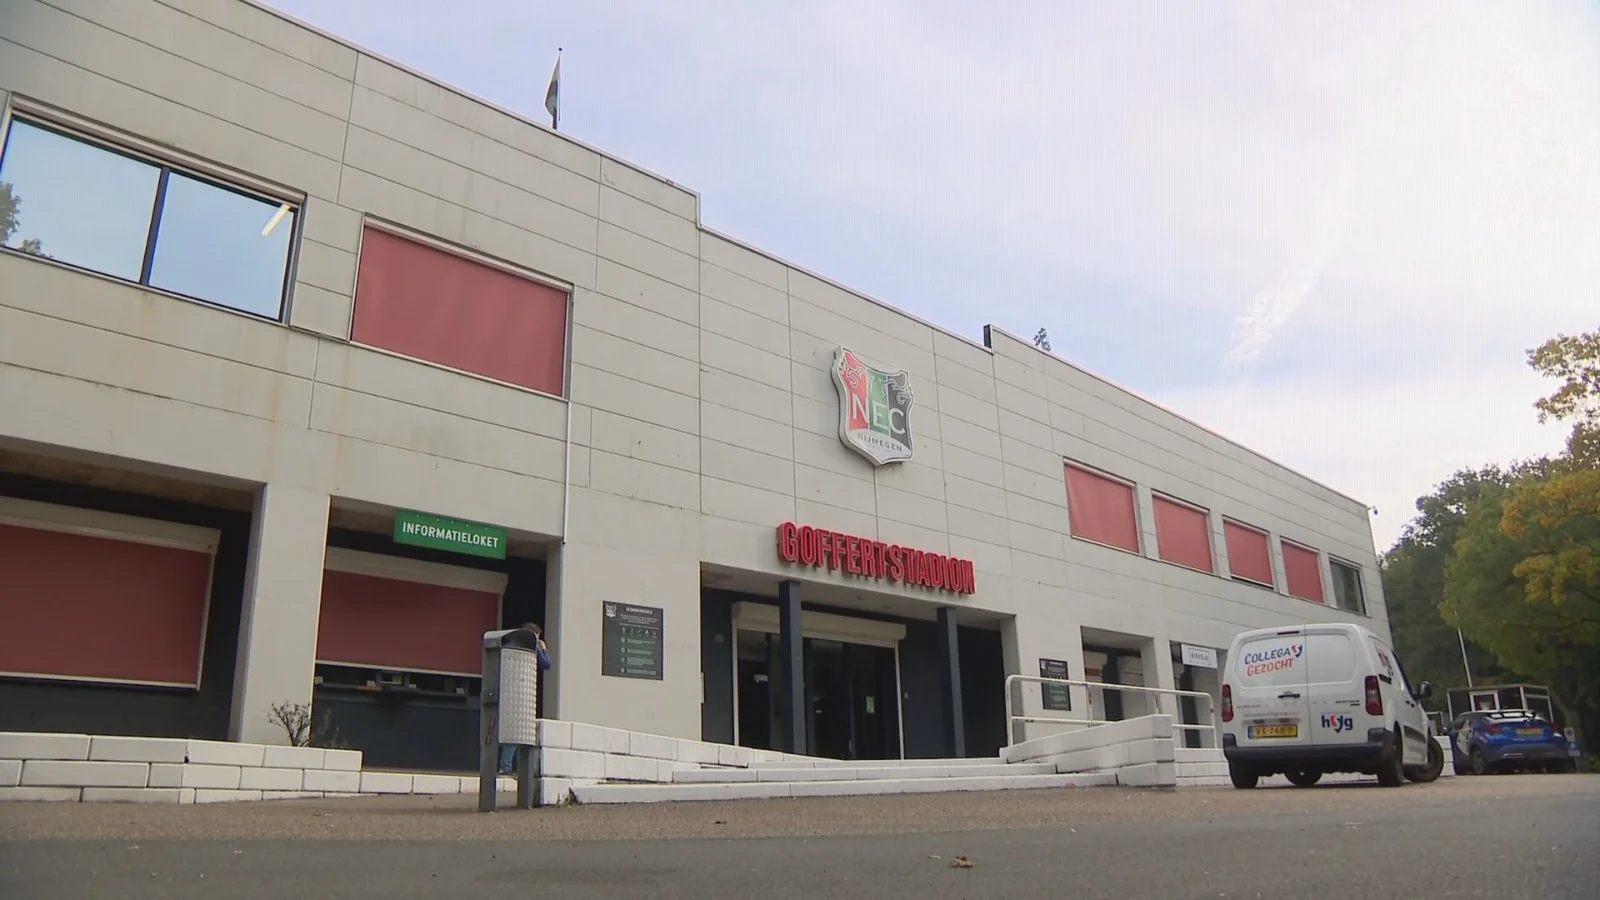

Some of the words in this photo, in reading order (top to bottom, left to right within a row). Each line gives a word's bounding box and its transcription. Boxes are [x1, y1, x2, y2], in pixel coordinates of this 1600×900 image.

[857, 432, 903, 453] NIJMEGEN
[402, 521, 499, 548] INFORMATIELOKET
[777, 521, 976, 595] GOFFERTSTADION
[1244, 646, 1291, 665] COLLEGA
[1247, 658, 1293, 677] GEZOCHT
